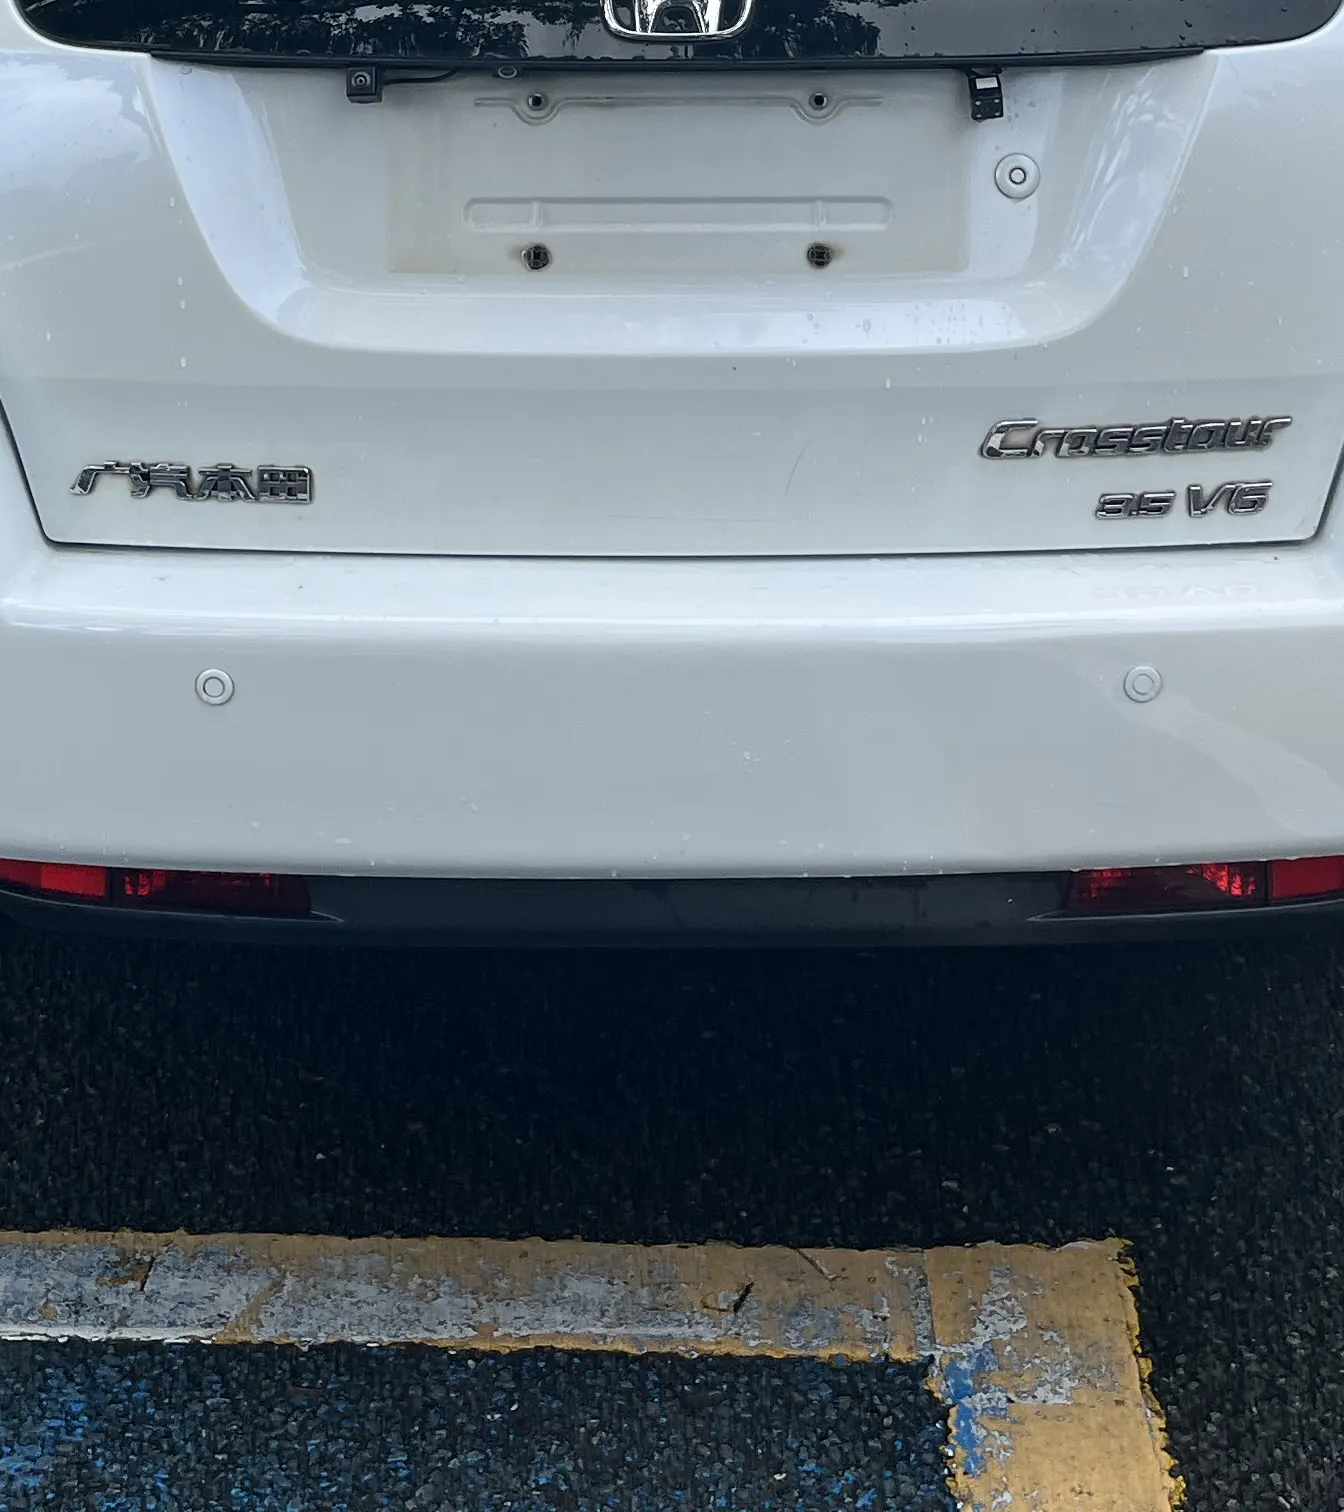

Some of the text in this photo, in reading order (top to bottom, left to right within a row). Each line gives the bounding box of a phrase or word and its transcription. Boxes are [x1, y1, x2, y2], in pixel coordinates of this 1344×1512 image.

[980, 416, 1293, 459] Crosstour
[1094, 480, 1273, 520] 3.5 V6
